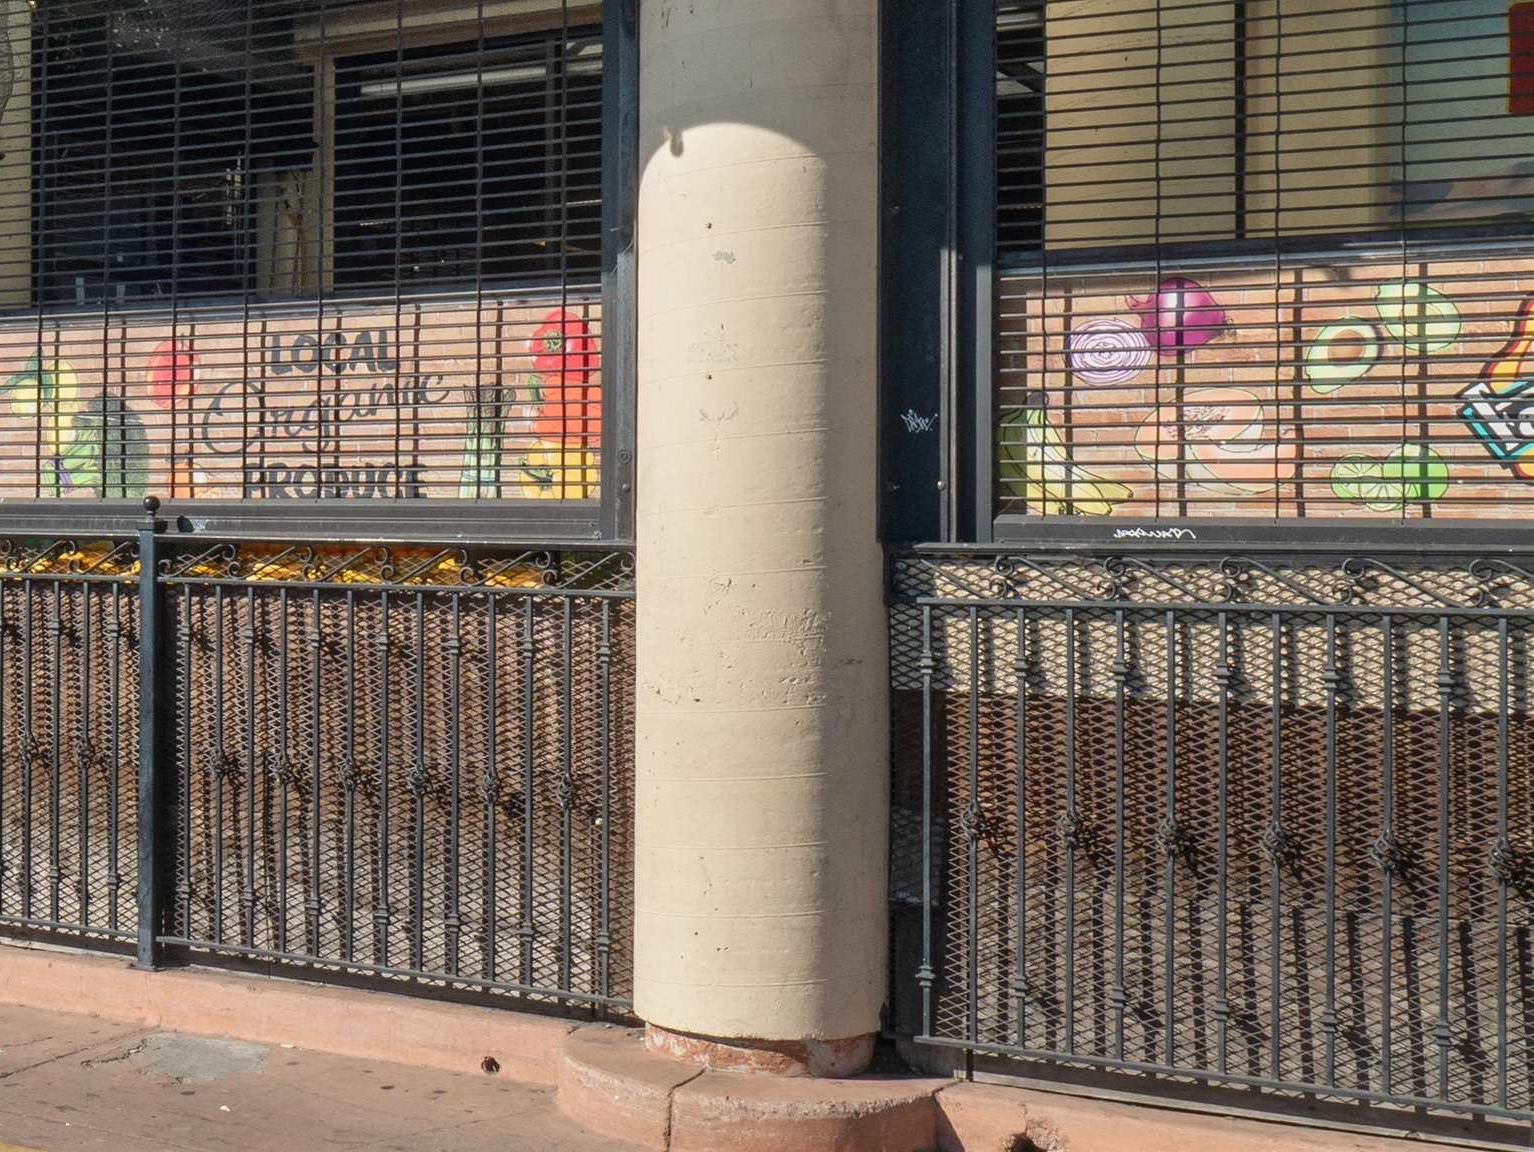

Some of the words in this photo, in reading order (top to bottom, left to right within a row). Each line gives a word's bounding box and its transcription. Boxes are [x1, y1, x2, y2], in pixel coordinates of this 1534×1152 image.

[269, 328, 398, 375] LOCAL
[202, 375, 450, 454] Organic
[243, 461, 429, 499] PRODUCE
